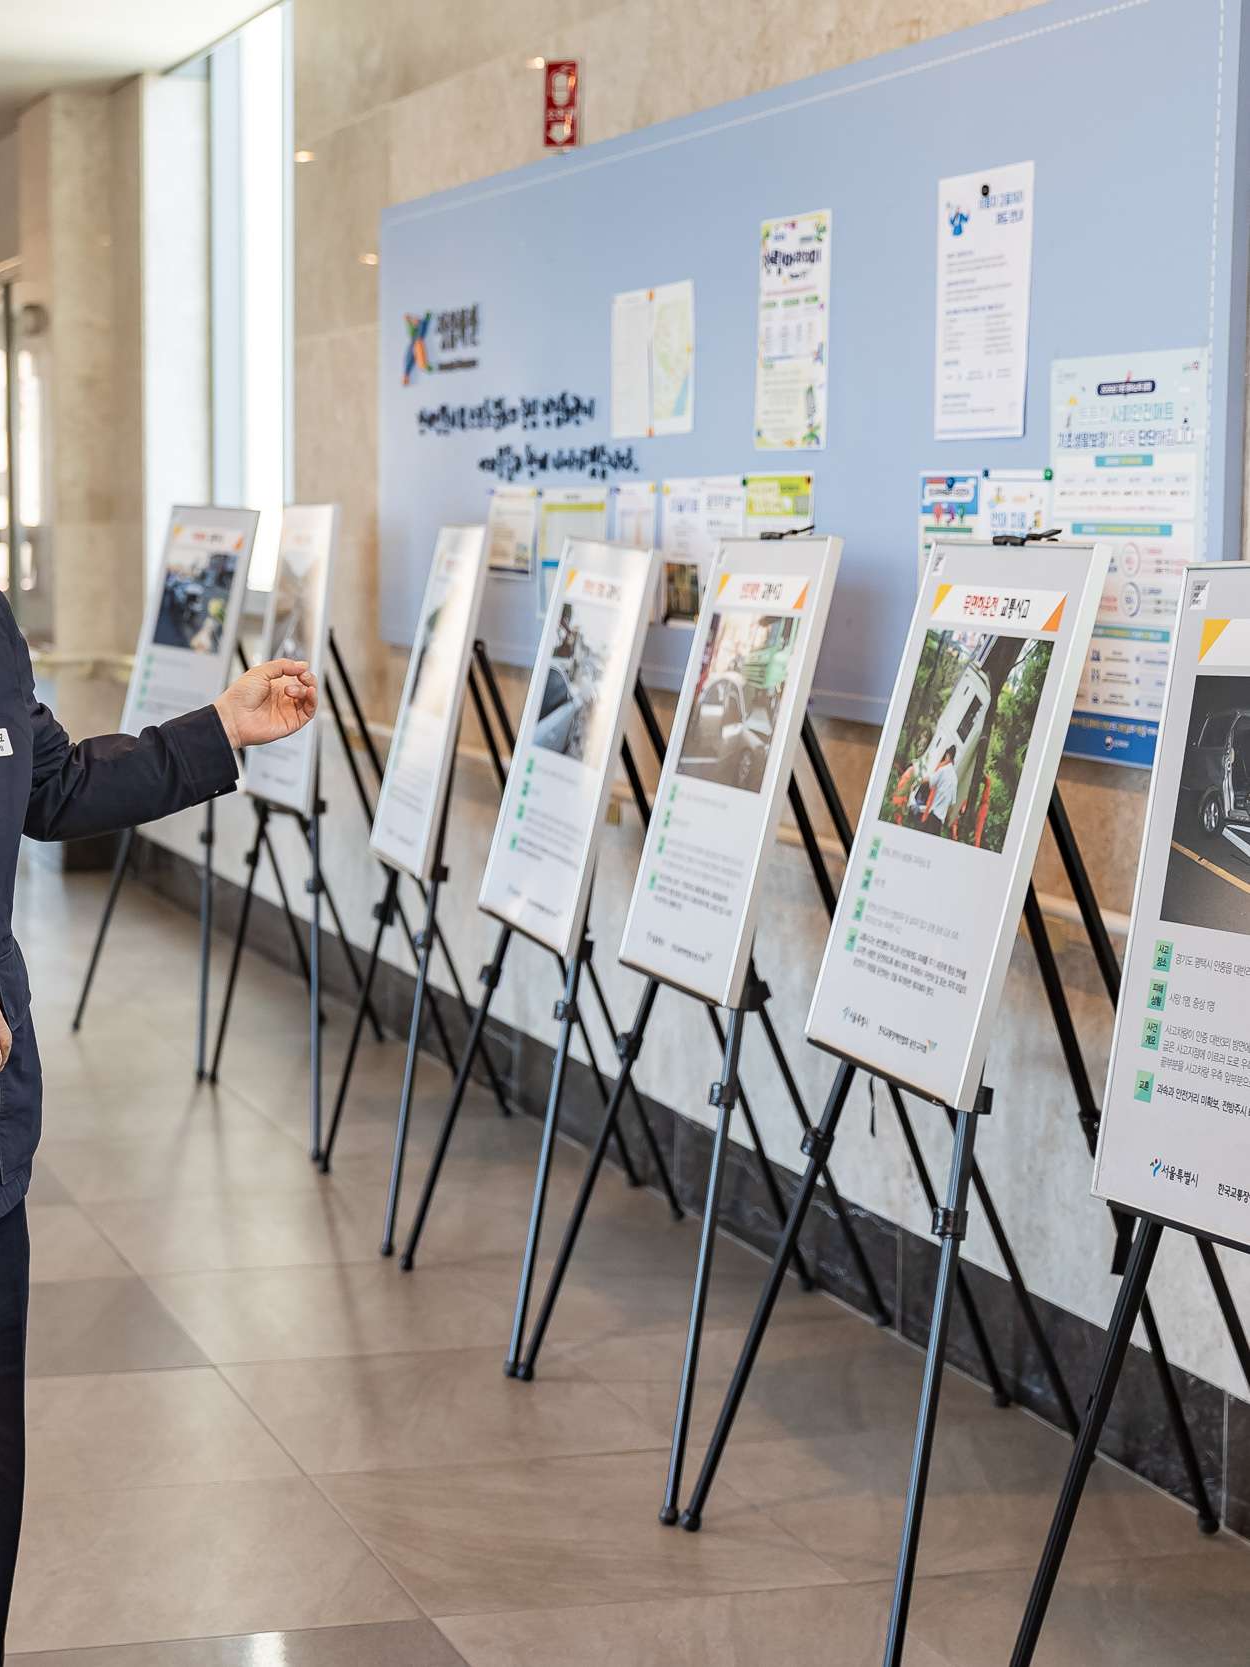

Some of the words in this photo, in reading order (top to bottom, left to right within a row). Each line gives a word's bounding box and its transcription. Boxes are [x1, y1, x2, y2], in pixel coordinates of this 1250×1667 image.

[963, 594, 999, 617] 무면허운전
[1000, 597, 1031, 619] 교통사고
[1158, 944, 1169, 954] 사고
[1157, 957, 1167, 967] 장소
[1175, 953, 1193, 966] 경기도
[1194, 956, 1213, 971] 평택시
[1214, 960, 1232, 974] 안중읍
[1152, 983, 1164, 993] 피해
[1151, 996, 1161, 1006] 상황
[1169, 992, 1181, 1005] 사망
[1193, 997, 1206, 1010] 중상
[1207, 1000, 1215, 1013] 1명
[1147, 1022, 1158, 1033] 사건
[1165, 1024, 1195, 1040] 사고차량이
[1195, 1030, 1208, 1044] 안중
[1145, 1035, 1156, 1045] 개요
[1163, 1040, 1175, 1053] 굽은
[1176, 1043, 1206, 1060] 사고지점에
[1207, 1051, 1226, 1065] 이르러
[1227, 1055, 1240, 1068] 도로
[1160, 1056, 1184, 1072] 끝부분을
[1184, 1063, 1210, 1079] 사고차량
[1210, 1068, 1223, 1081] 우측
[1138, 1080, 1149, 1091] 교훈
[1156, 1083, 1175, 1097] 과속과
[1175, 1088, 1200, 1104] 안전거리
[1200, 1095, 1220, 1111] 미확보,
[1221, 1100, 1247, 1117] 전방주시
[1161, 1164, 1199, 1188] 서울특별시
